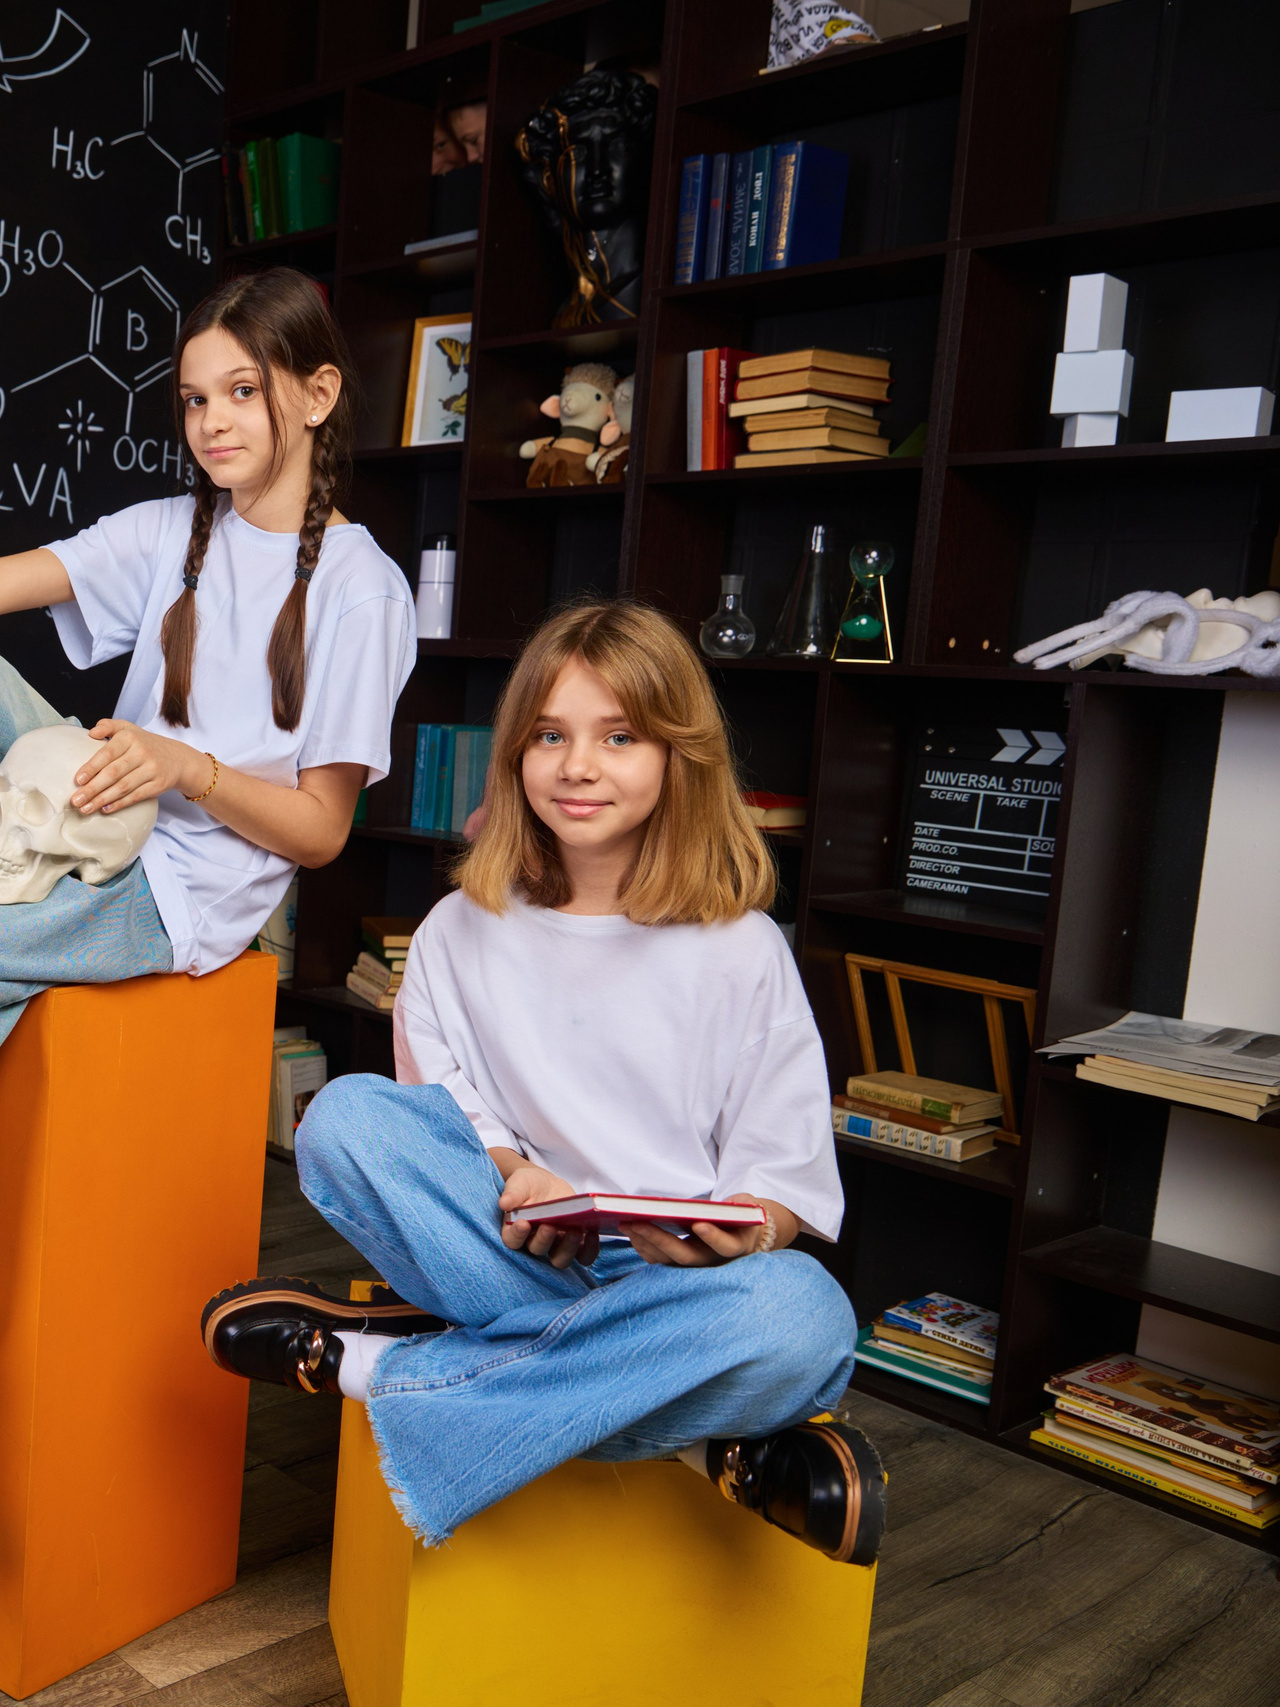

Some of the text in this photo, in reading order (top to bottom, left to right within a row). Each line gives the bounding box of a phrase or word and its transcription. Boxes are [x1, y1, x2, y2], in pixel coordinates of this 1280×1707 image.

[180, 28, 198, 63] N
[127, 310, 147, 350] B
[925, 769, 1007, 791] UNIVERSAL
[930, 789, 970, 803] SCENE
[996, 796, 1028, 809] TAKE
[914, 826, 941, 838] DATE
[912, 841, 959, 856] PROD.CO.
[909, 859, 961, 875] DIRECTOR
[906, 877, 969, 895] CAMERAMAN
[932, 1329, 985, 1354] СТИХИ ДЕТЯМ
[1047, 1440, 1090, 1461] ПАМЯТЬ
[1213, 1504, 1238, 1519] Инна
